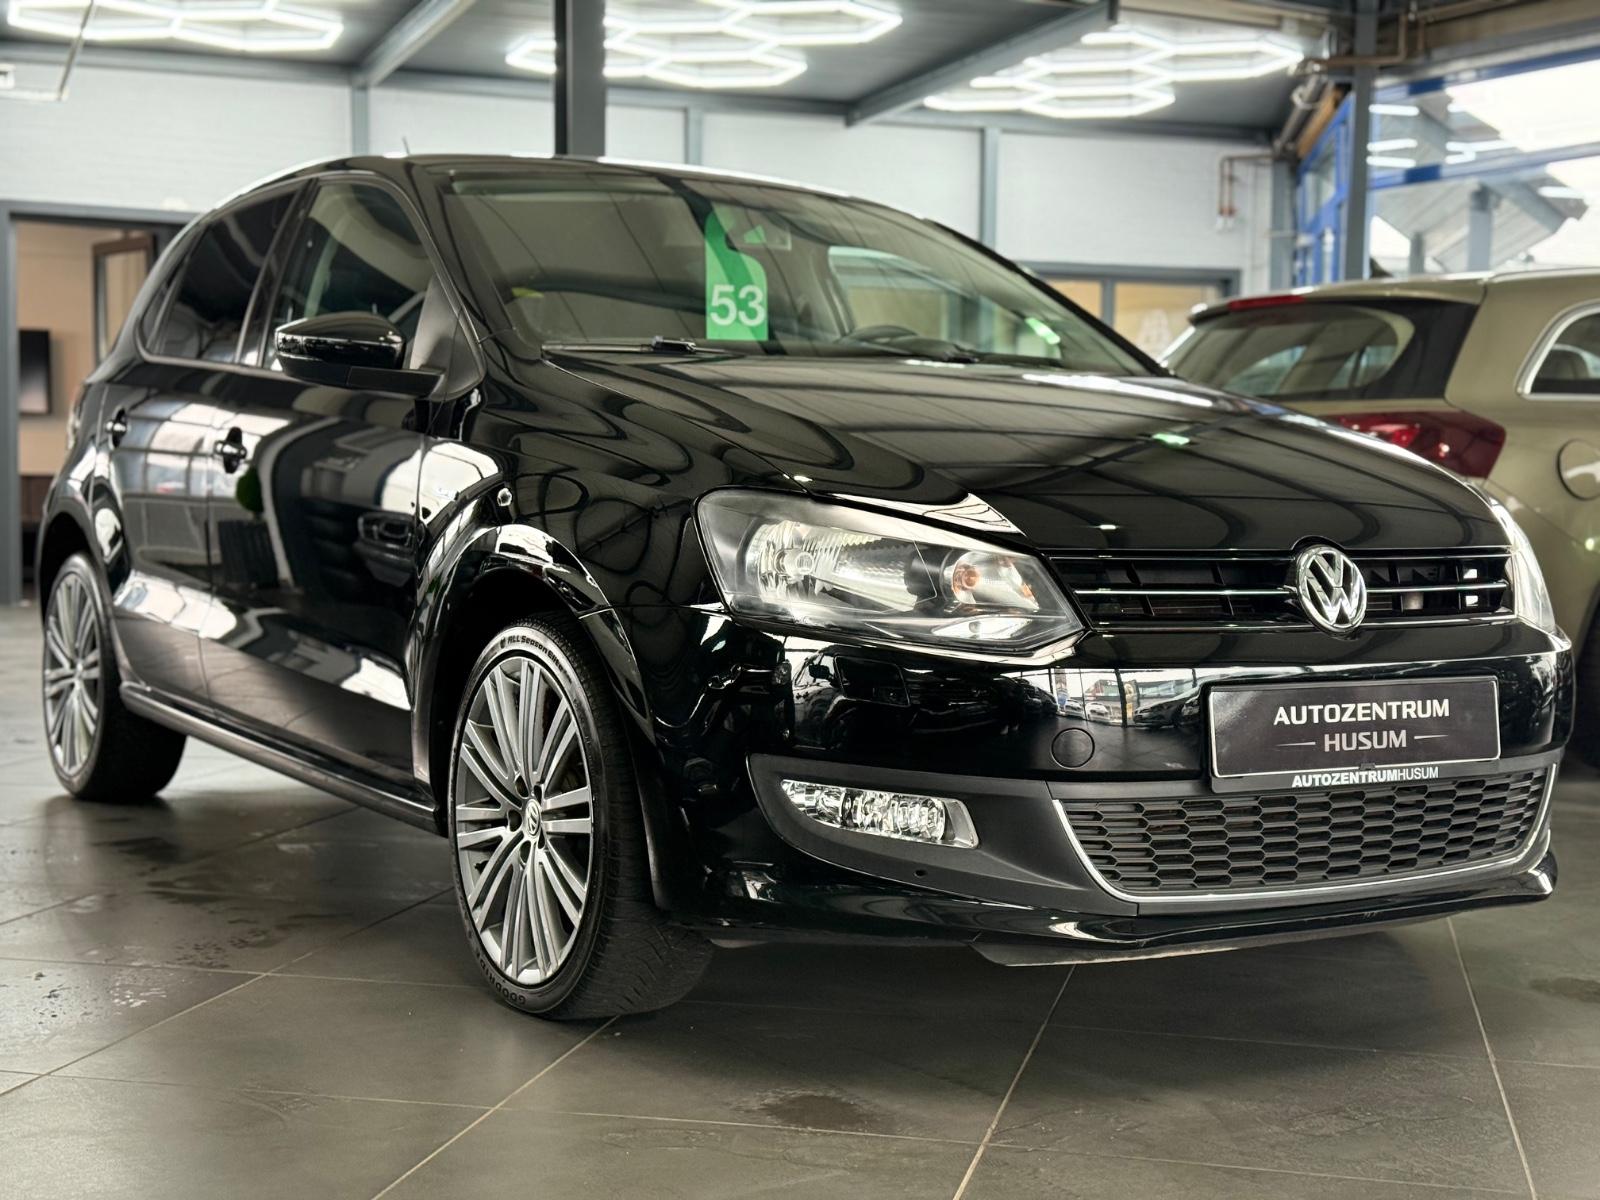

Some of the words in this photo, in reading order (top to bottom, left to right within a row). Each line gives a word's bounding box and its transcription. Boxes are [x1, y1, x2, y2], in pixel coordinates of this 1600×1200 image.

[710, 284, 776, 326] 53
[1299, 546, 1365, 629] VW
[1273, 698, 1450, 726] AUTOZENTRUM
[1324, 729, 1407, 753] HUSUM
